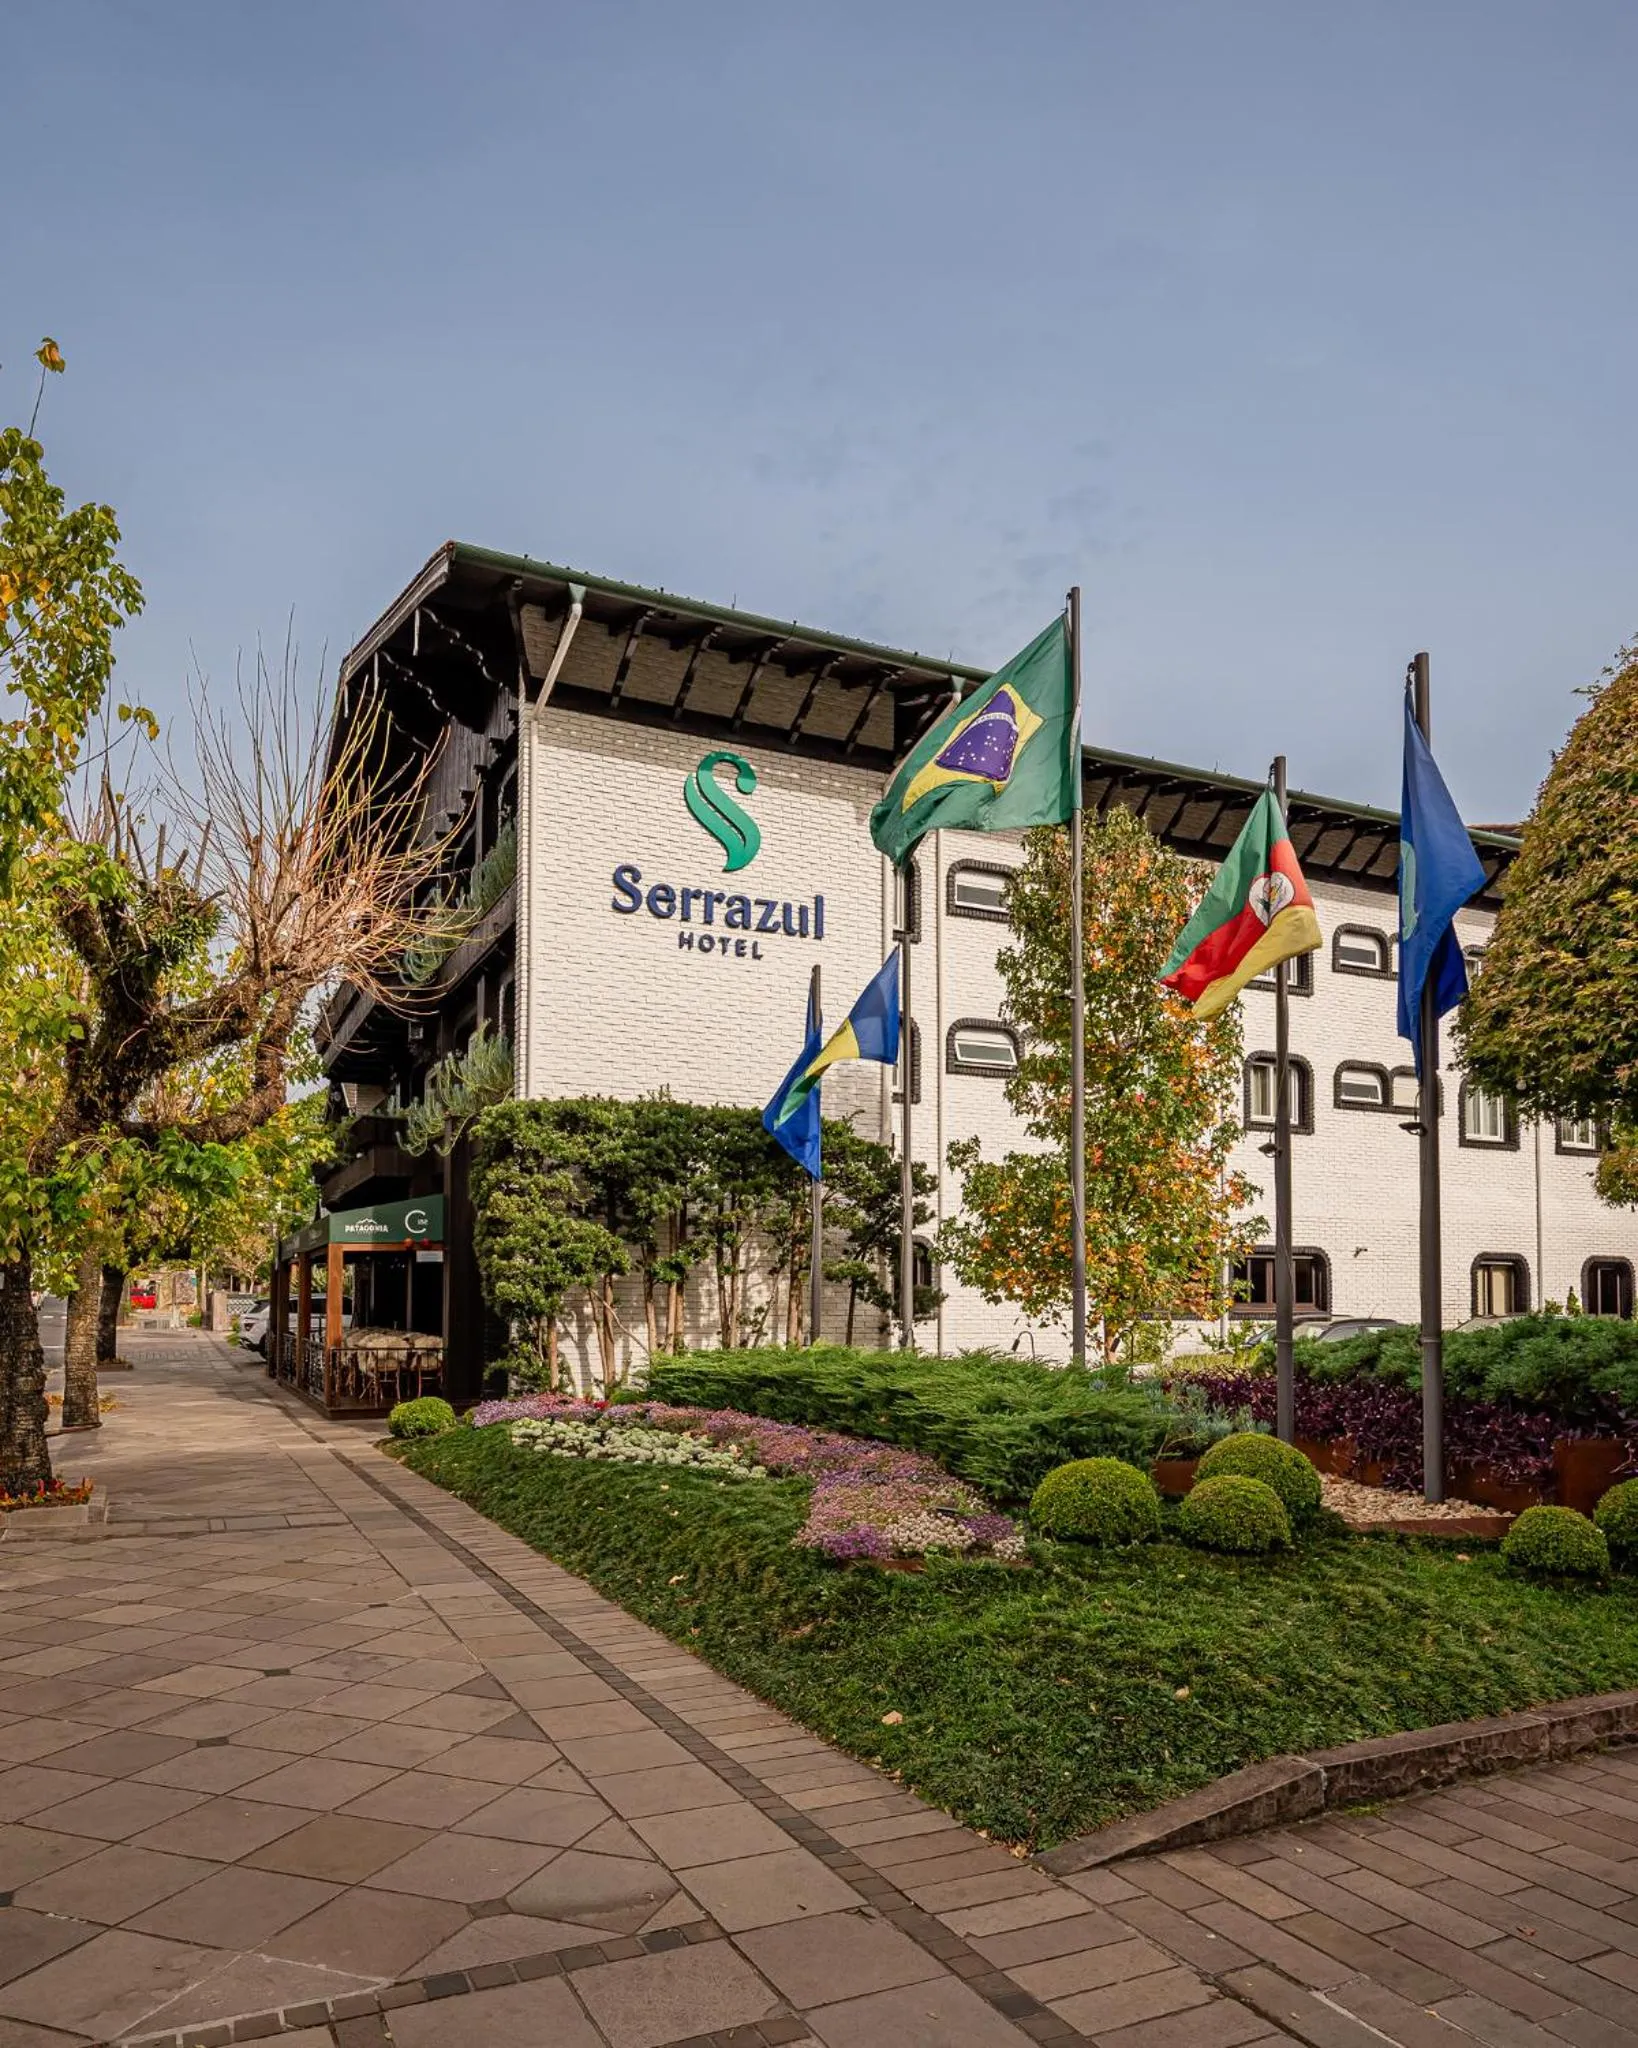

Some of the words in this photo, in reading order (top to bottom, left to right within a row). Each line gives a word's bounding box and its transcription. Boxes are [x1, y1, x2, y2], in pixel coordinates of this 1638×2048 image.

[612, 864, 824, 940] Serrazul
[678, 931, 764, 960] HOTEL
[344, 1224, 389, 1233] PATAGONIA
